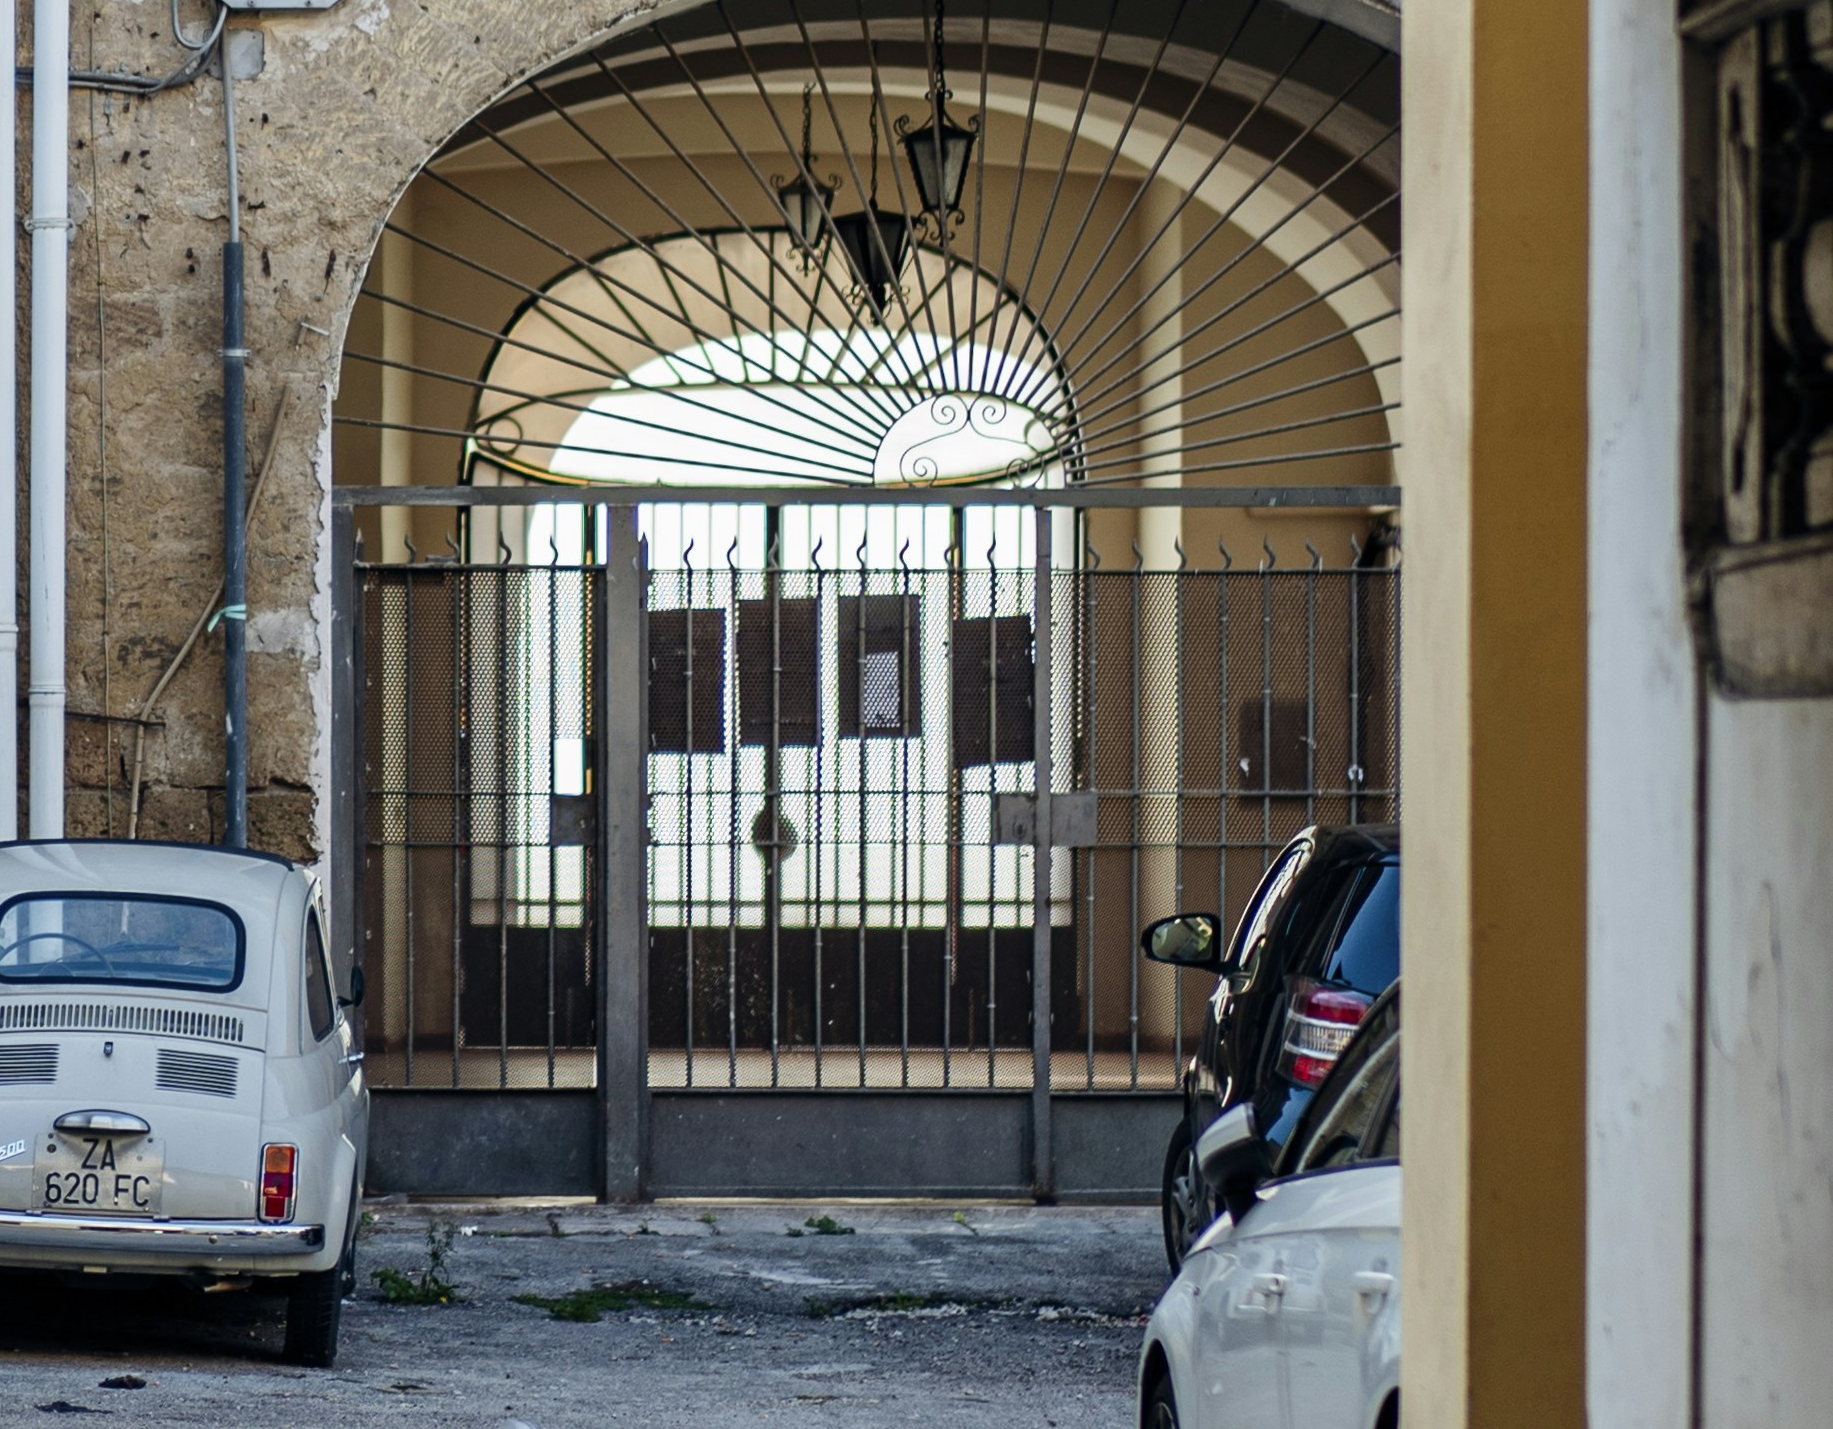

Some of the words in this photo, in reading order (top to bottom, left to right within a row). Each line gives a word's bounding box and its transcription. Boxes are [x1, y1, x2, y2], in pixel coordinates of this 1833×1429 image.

[81, 1138, 116, 1171] ZA
[45, 1171, 99, 1204] 620
[113, 1174, 150, 1207] FC
